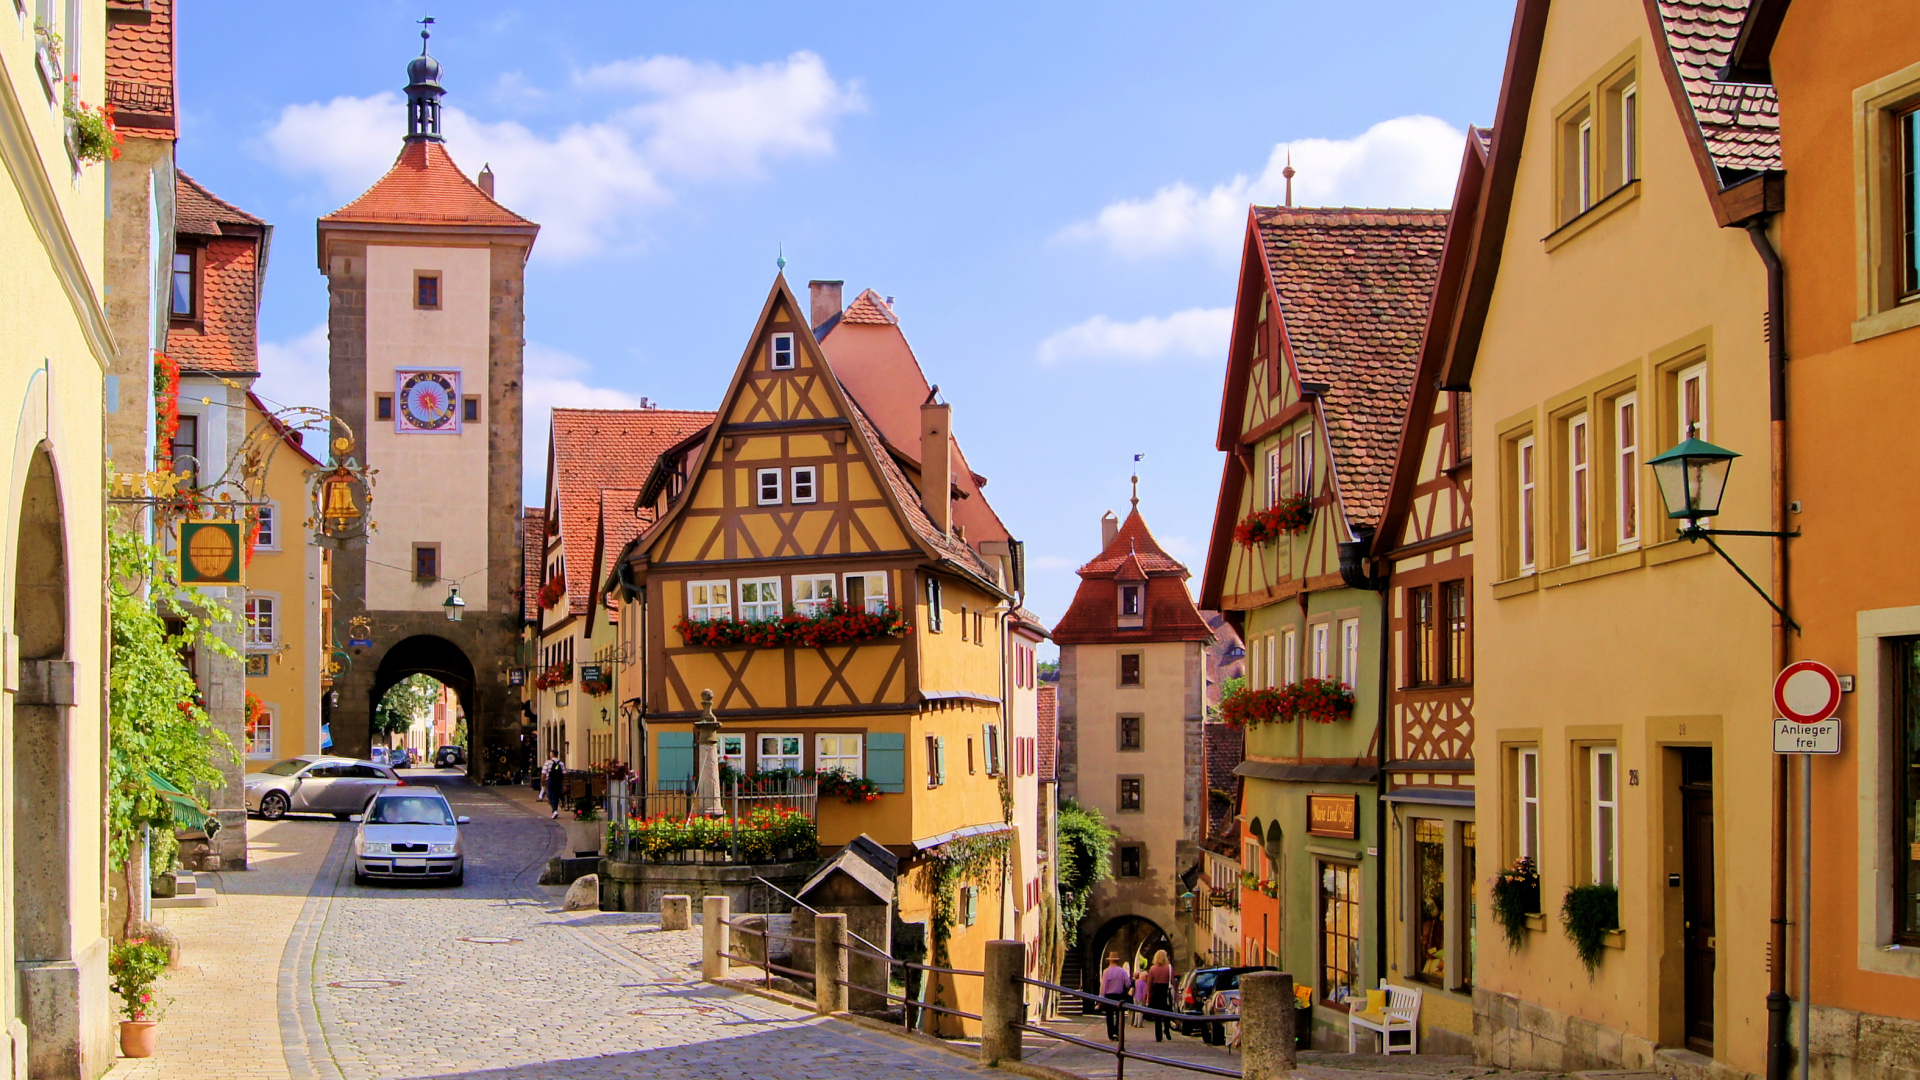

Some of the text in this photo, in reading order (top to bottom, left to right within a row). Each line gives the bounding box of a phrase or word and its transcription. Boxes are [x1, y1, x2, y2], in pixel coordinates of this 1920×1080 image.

[1781, 724, 1832, 737] Anlieger
[1796, 738, 1817, 748] frei
[1629, 769, 1639, 786] 28
